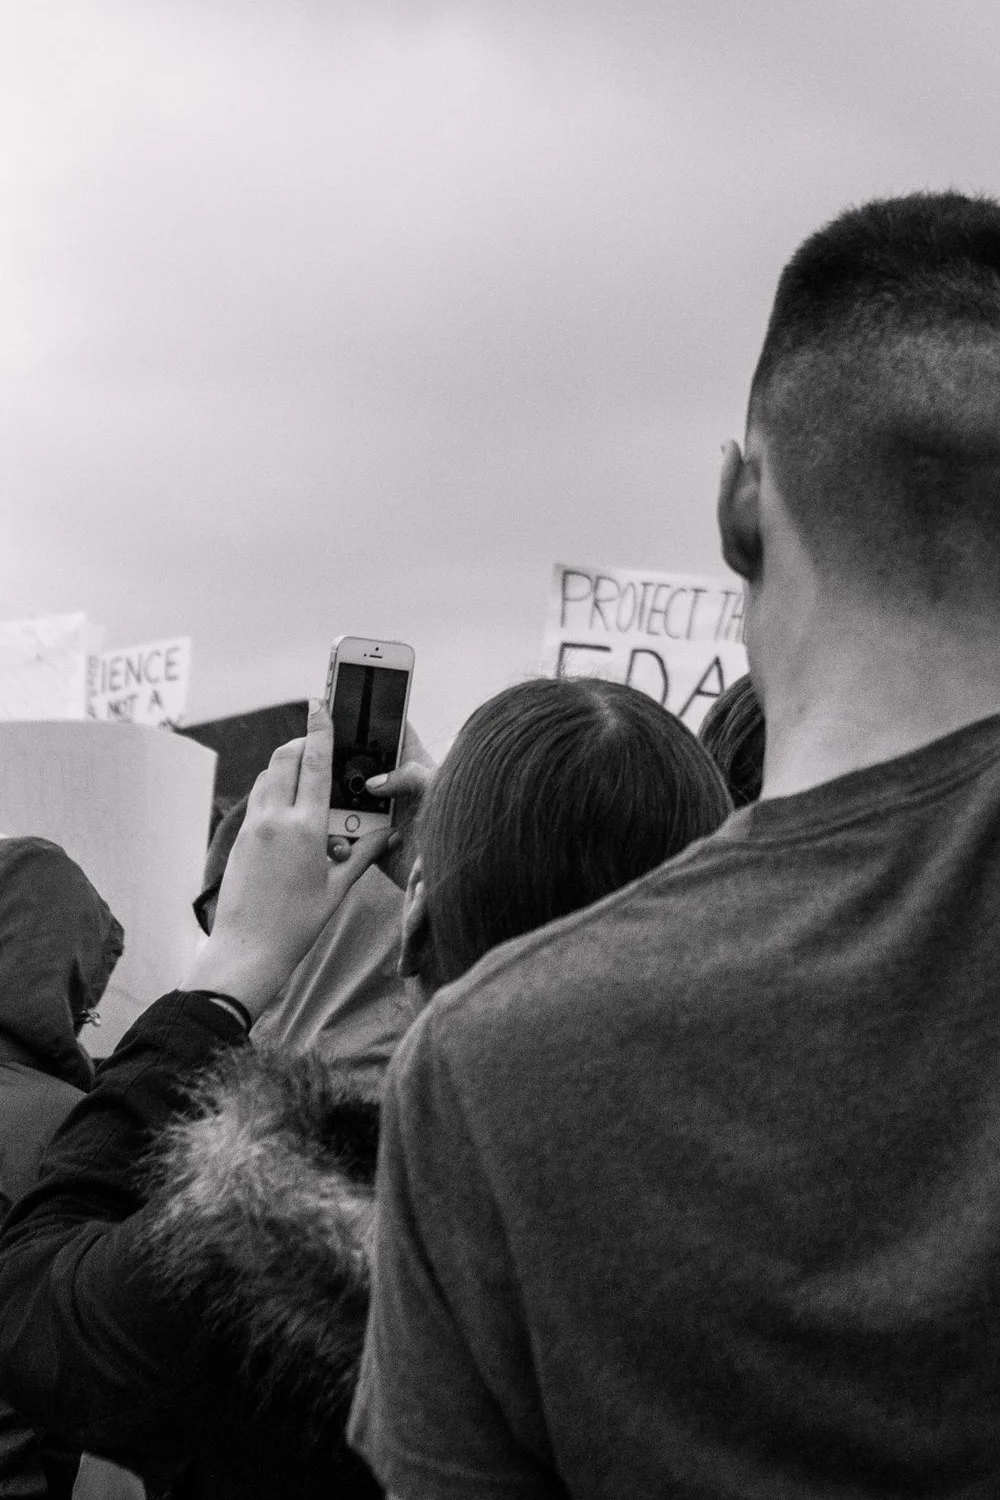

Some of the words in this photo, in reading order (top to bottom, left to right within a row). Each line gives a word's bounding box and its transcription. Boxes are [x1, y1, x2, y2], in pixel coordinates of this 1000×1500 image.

[560, 569, 708, 640] PROTECT
[713, 589, 744, 643] TH
[101, 646, 181, 695] IENCE
